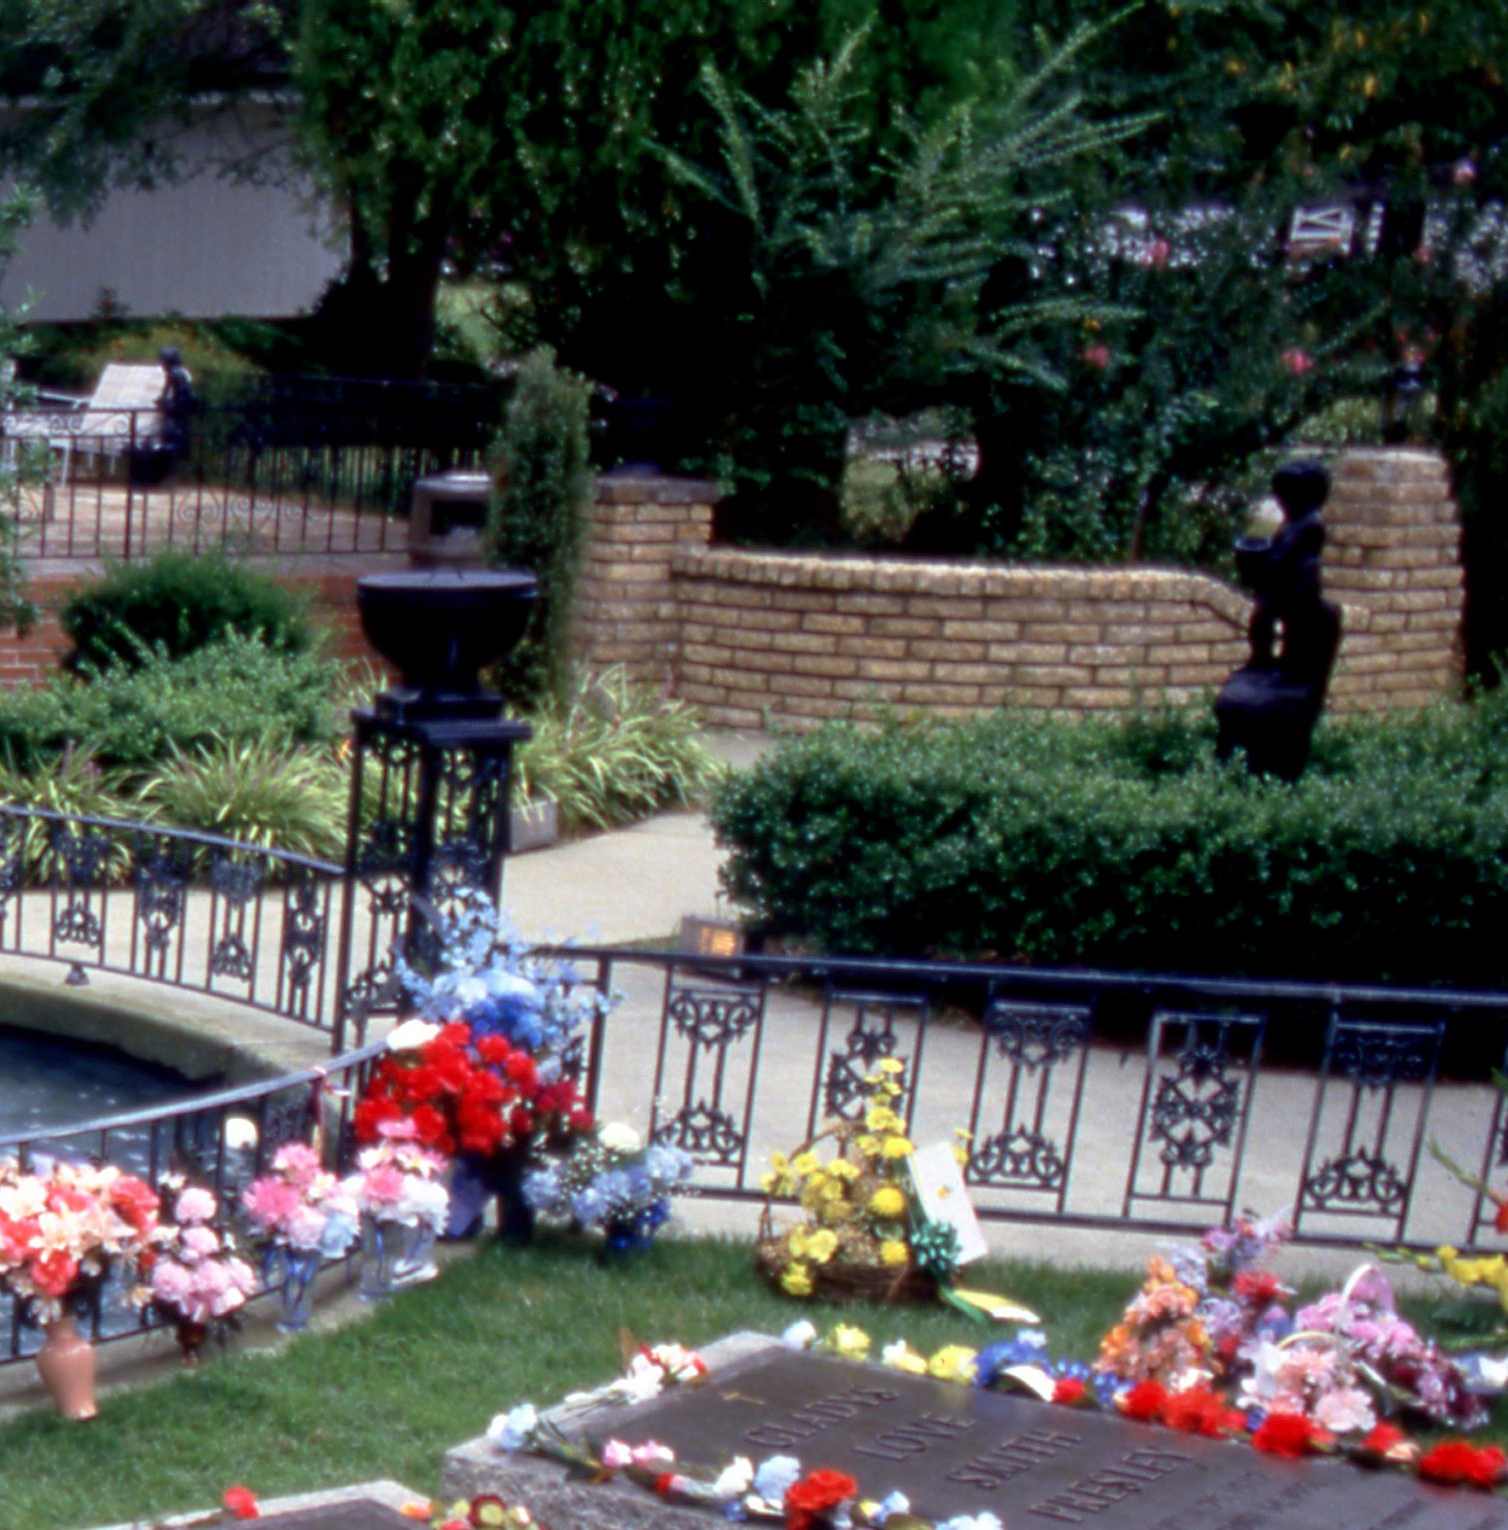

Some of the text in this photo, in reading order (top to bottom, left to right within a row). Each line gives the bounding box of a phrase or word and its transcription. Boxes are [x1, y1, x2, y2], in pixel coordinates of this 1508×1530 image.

[745, 1385, 899, 1450] GLADYS
[851, 1412, 976, 1462] LOVE
[947, 1426, 1082, 1490] SMITH
[1028, 1445, 1192, 1523] PRESLEY
